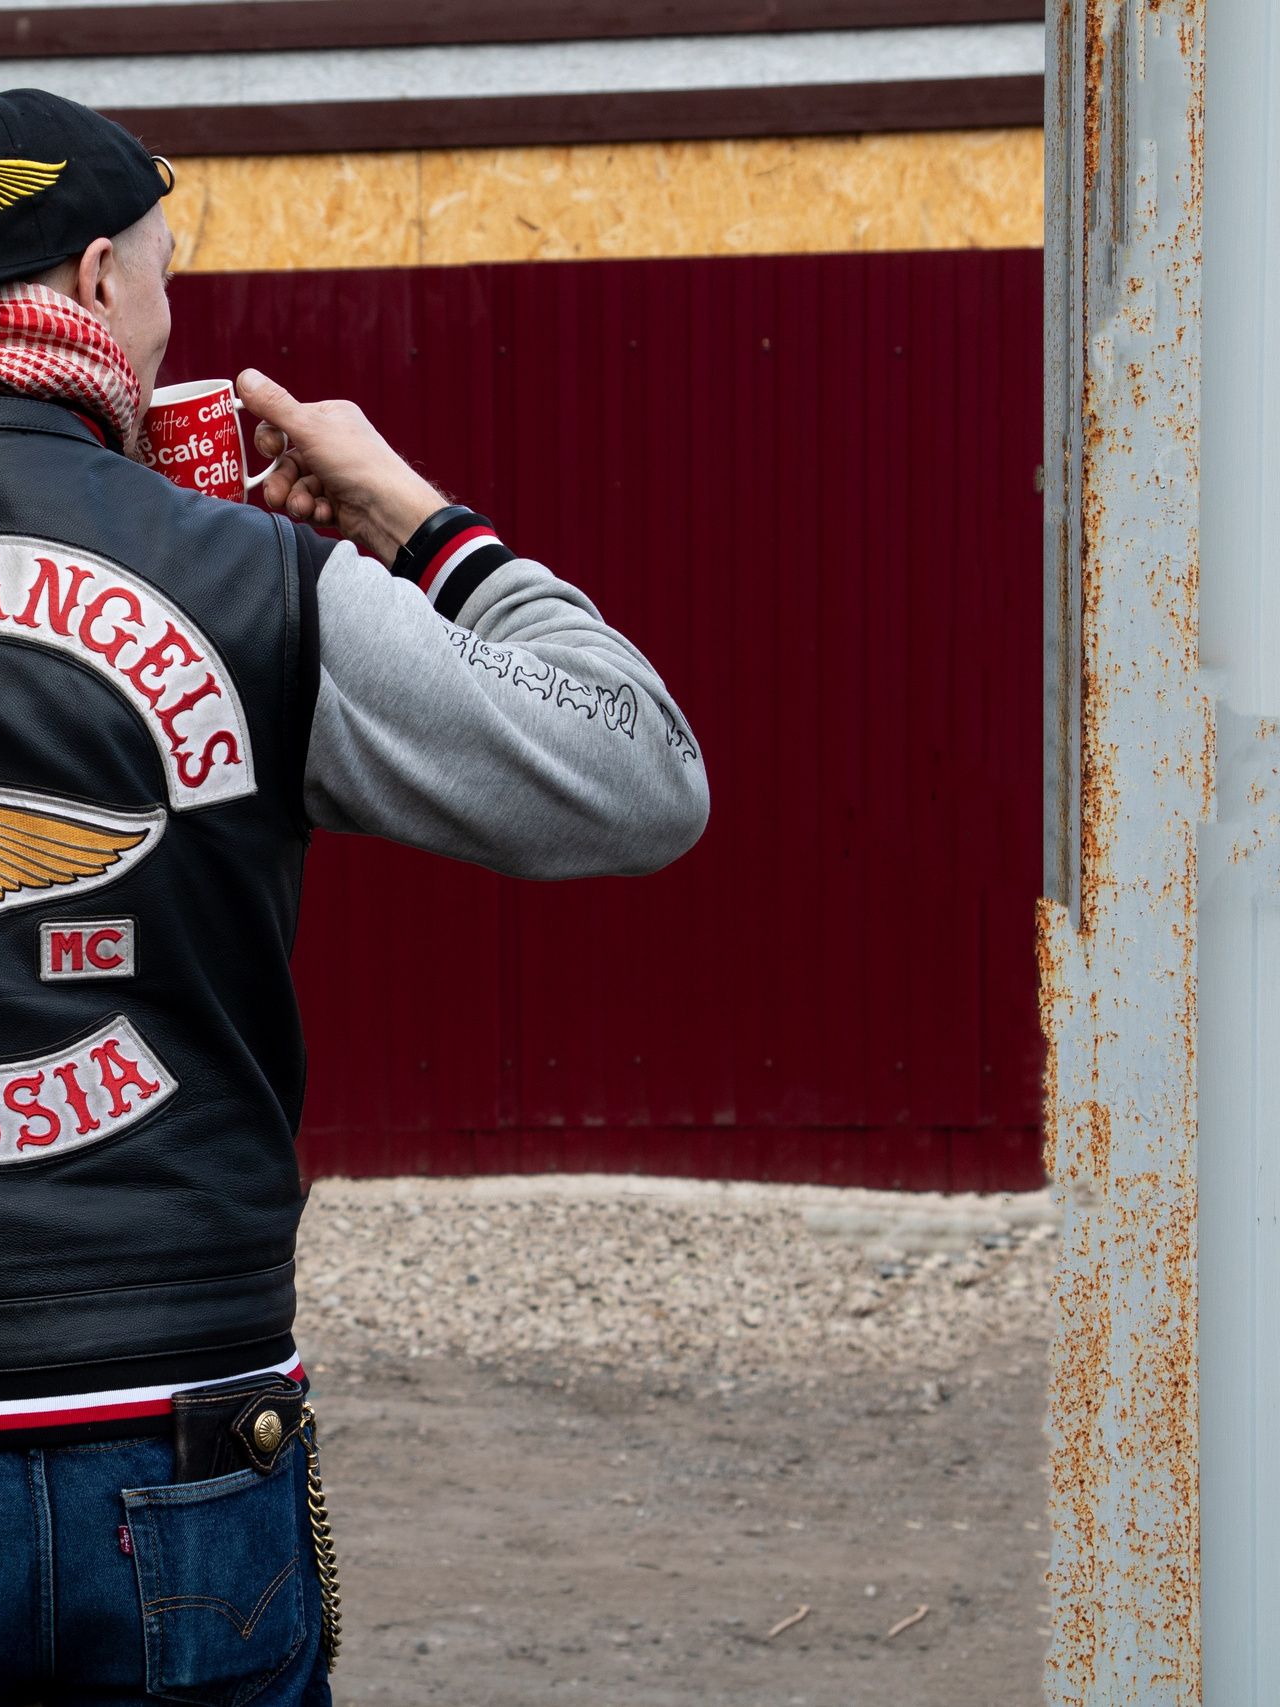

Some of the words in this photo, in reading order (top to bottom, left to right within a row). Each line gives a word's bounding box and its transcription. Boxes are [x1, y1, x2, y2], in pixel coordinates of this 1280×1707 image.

[198, 393, 234, 422] café
[151, 410, 190, 441] coffee
[214, 420, 237, 446] coffee
[158, 431, 214, 465] café
[194, 450, 239, 488] café
[51, 929, 125, 972] MC
